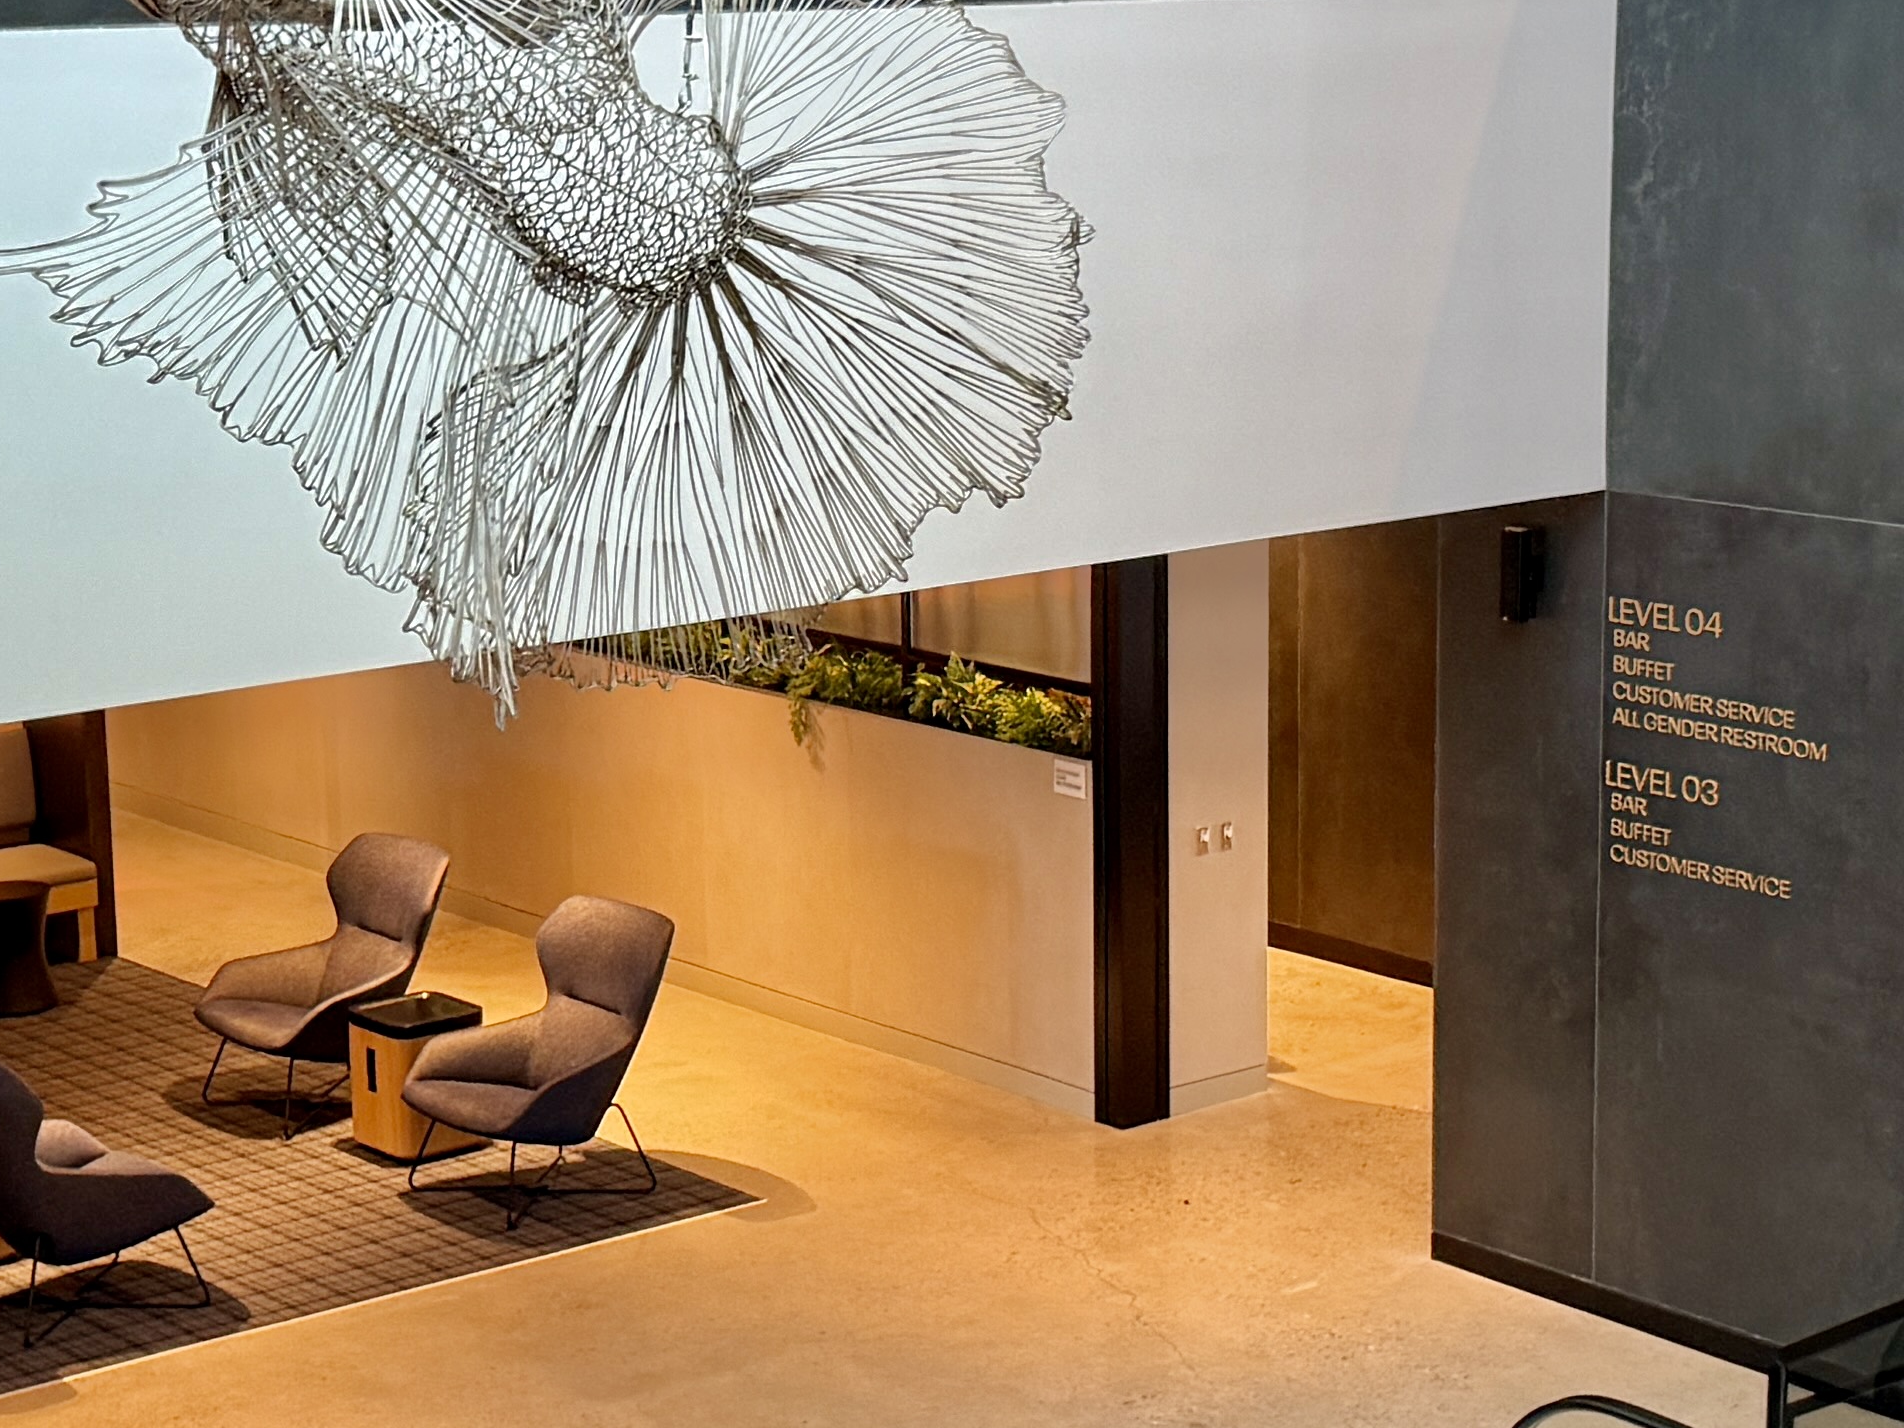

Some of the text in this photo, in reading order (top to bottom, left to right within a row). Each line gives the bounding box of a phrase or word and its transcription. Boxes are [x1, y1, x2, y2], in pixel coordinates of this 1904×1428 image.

[1608, 596, 1723, 638] LEVEL 04
[1613, 629, 1650, 651] BAR
[1613, 655, 1674, 681] BUFFET
[1612, 681, 1795, 730] CUSTOMER SERVICE
[1612, 708, 1828, 761] ALL GENDER RESTROOM
[1605, 760, 1719, 806] LEVEL 03
[1611, 793, 1647, 816] BAR
[1610, 818, 1672, 846] BUFFET
[1610, 844, 1792, 899] CUSTOMER SERVICE
